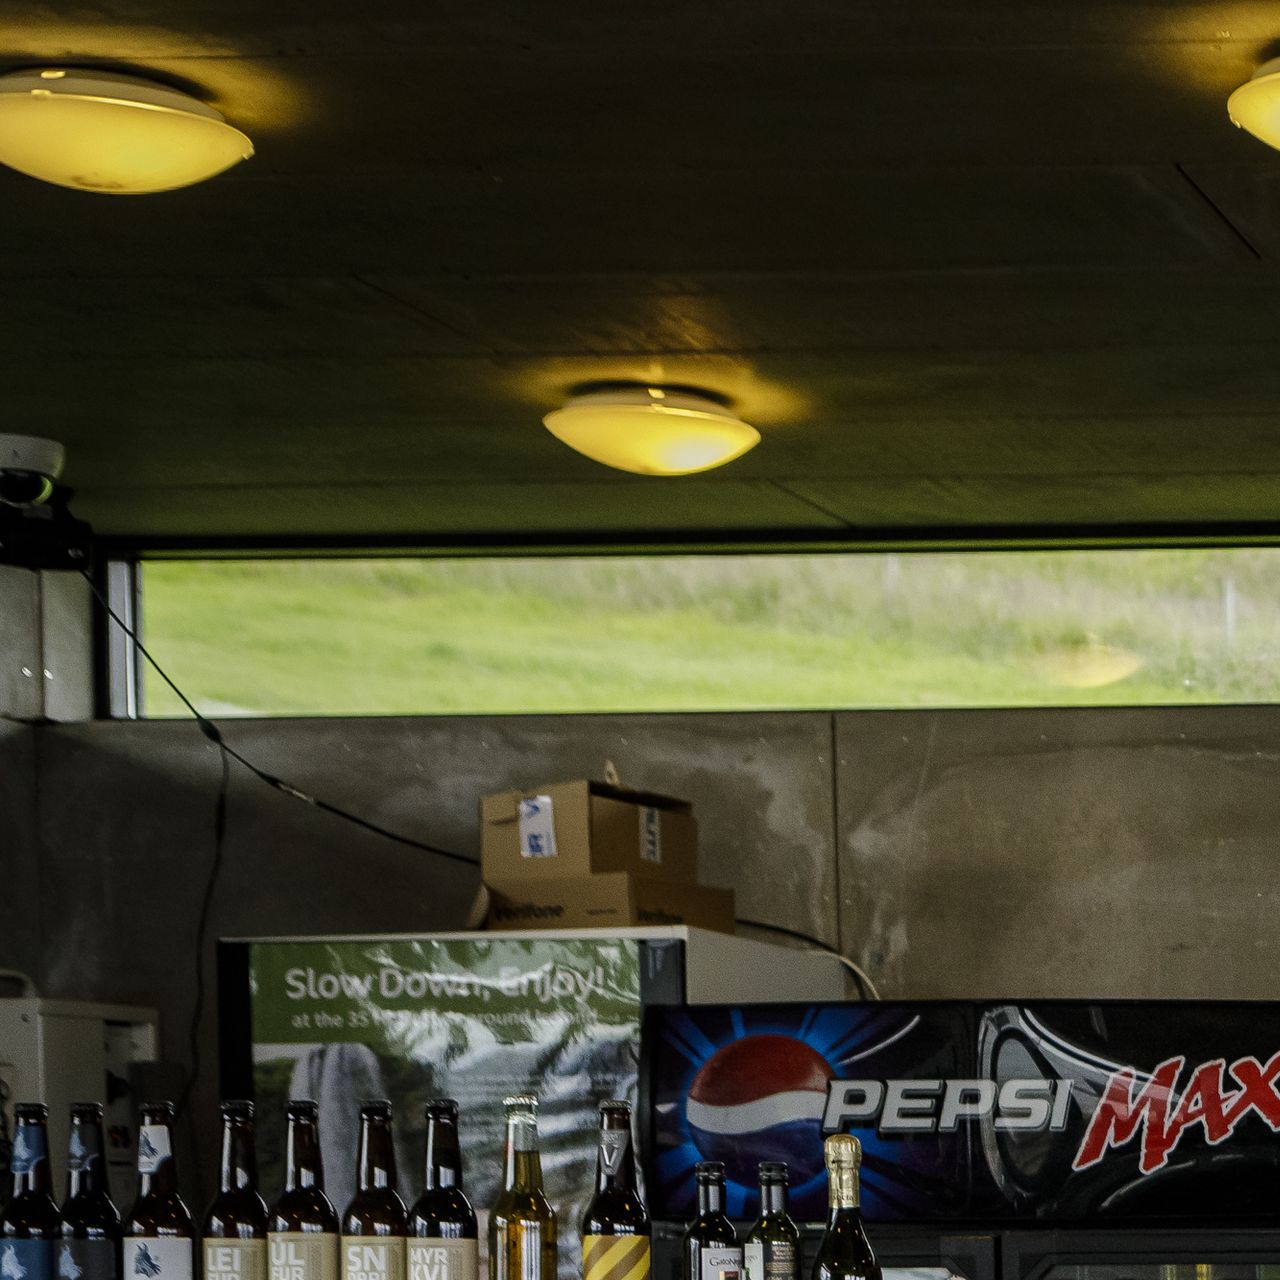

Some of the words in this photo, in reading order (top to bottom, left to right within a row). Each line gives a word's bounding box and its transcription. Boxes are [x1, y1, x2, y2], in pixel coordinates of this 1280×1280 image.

[285, 967, 372, 999] Slow
[314, 1011, 343, 1028] the
[820, 1077, 1075, 1134] PEPSI
[207, 1247, 240, 1271] LEI
[348, 1245, 385, 1272] SN
[410, 1247, 449, 1265] MYR
